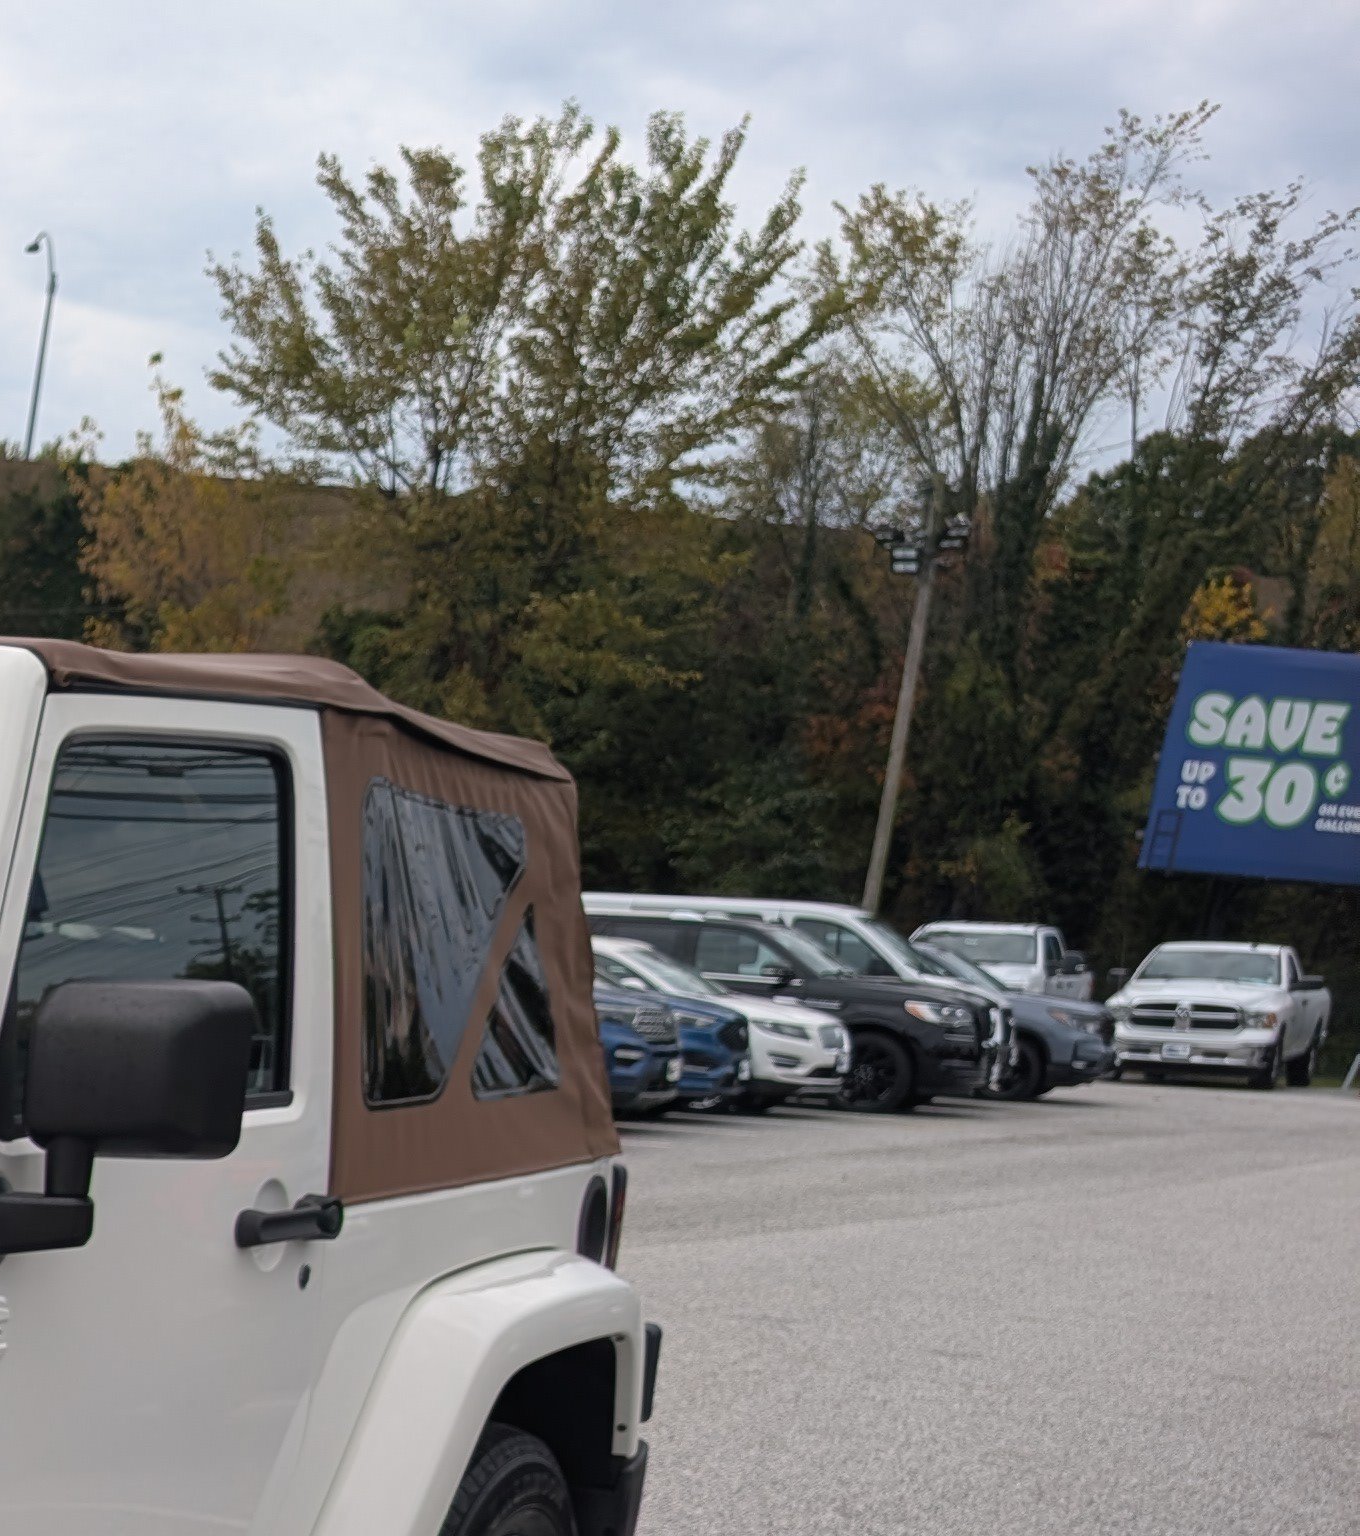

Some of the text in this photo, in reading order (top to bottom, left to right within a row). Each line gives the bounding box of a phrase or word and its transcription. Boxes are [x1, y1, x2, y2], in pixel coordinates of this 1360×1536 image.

[1188, 693, 1349, 754] SAVE
[1181, 760, 1216, 783] UP
[1177, 785, 1207, 810] TO
